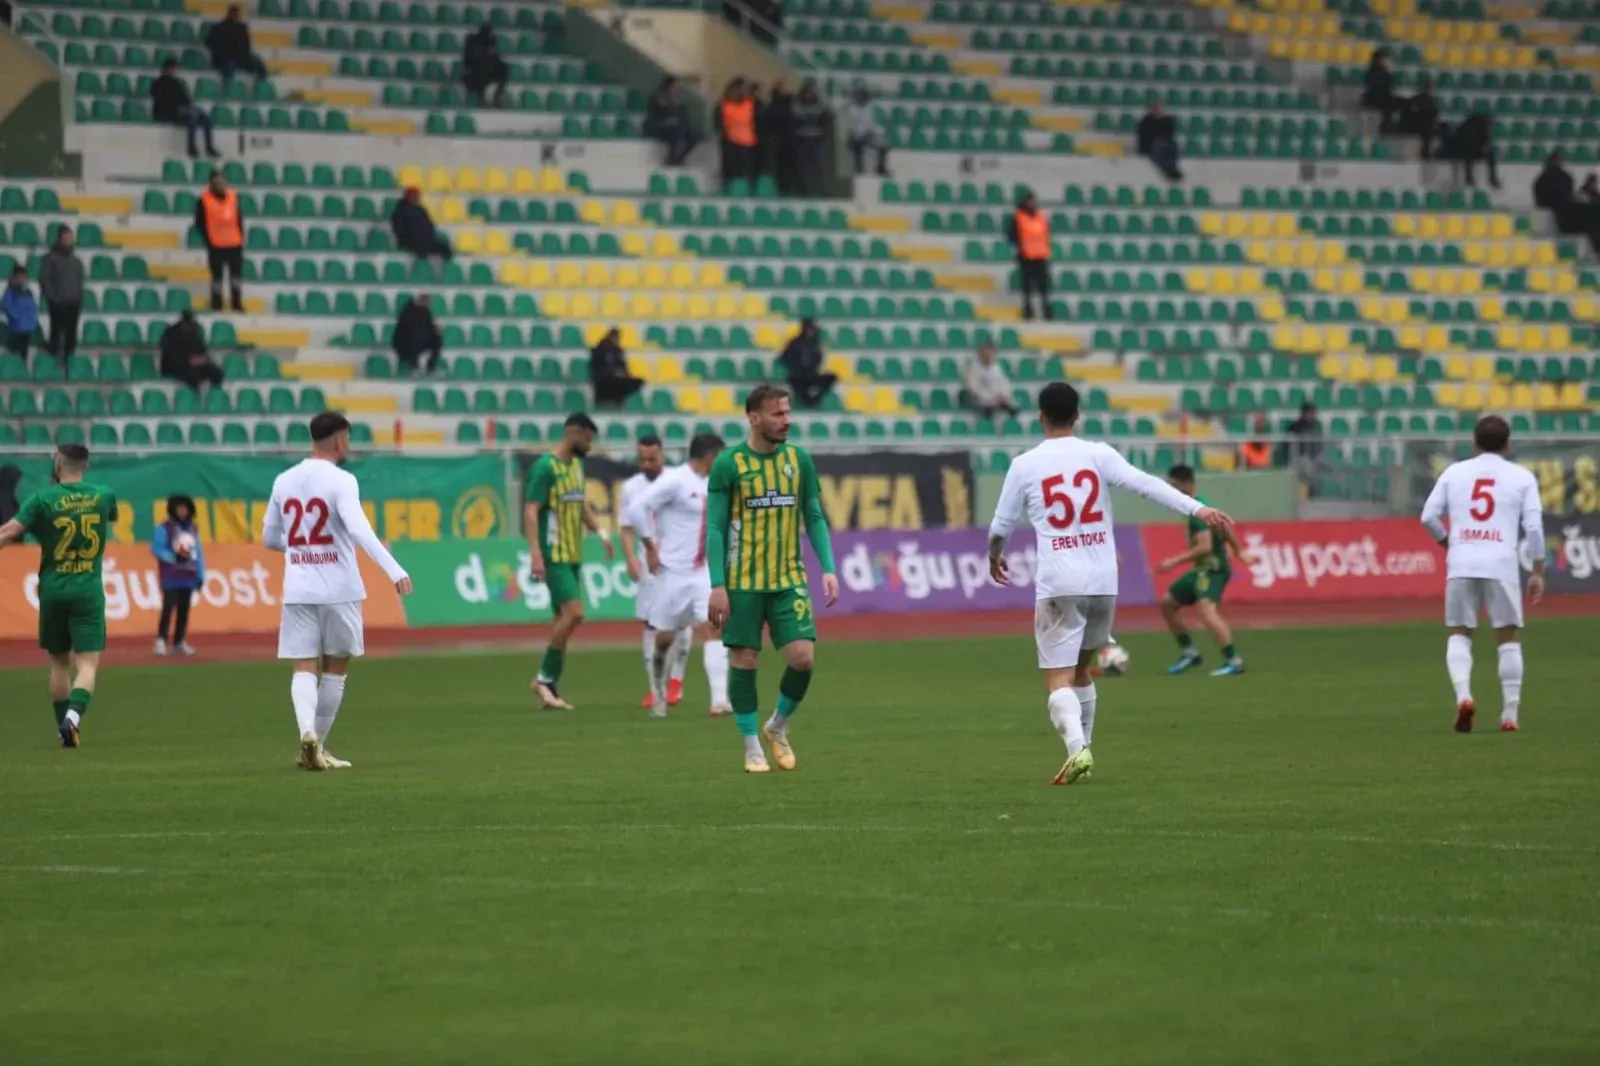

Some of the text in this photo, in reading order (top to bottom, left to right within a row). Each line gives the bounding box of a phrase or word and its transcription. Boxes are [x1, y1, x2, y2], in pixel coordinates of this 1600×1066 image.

[283, 497, 335, 547] 22
[1041, 469, 1104, 530] 52
[1469, 477, 1496, 523] 5
[53, 513, 101, 560] 25
[1052, 531, 1107, 551] EREN TOKA
